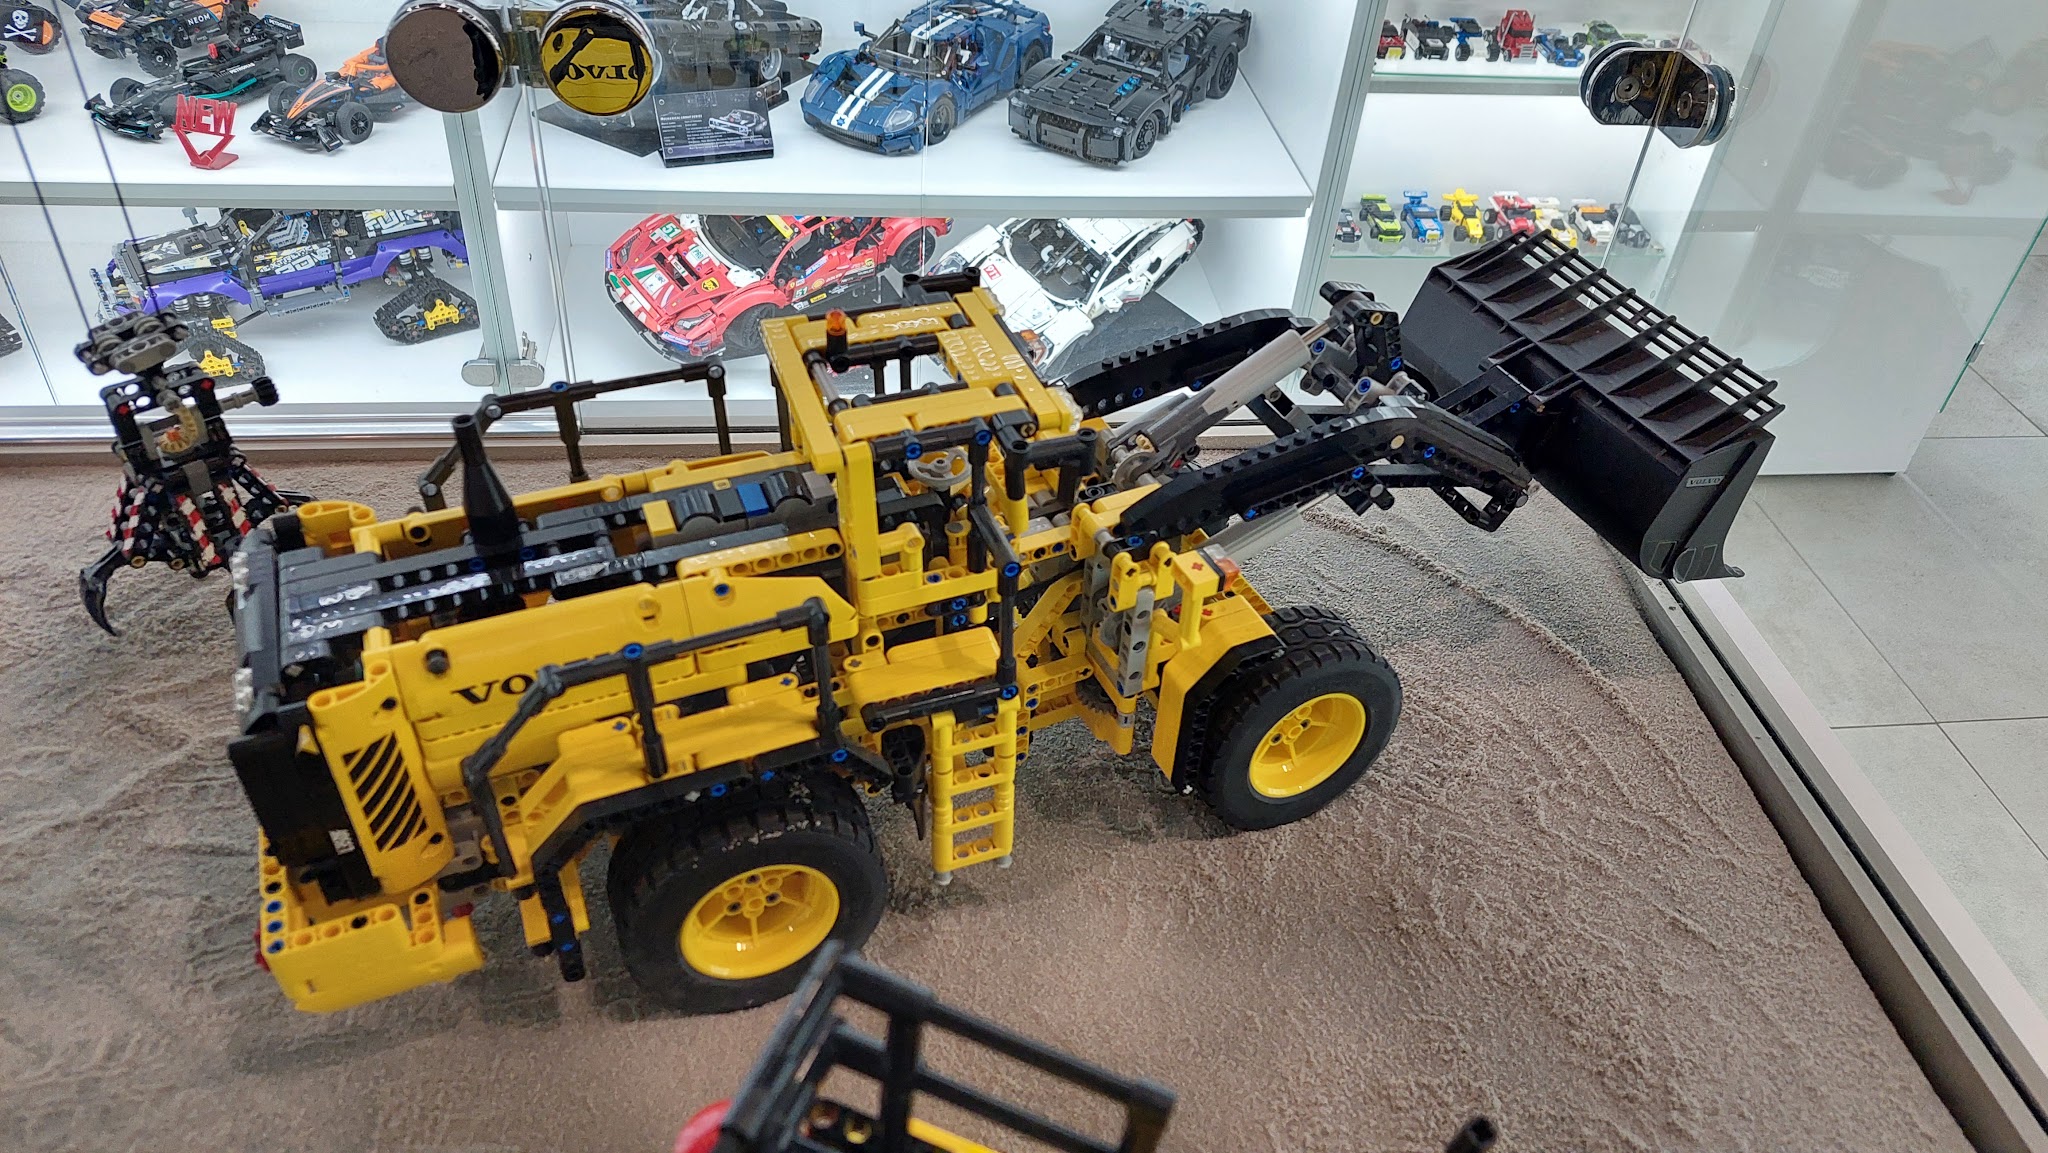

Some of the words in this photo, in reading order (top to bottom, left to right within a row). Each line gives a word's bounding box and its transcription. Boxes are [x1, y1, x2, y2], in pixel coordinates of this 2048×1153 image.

[187, 13, 211, 26] NEOM
[175, 94, 237, 135] NEW
[1690, 477, 1721, 485] VOLVO
[450, 672, 537, 705] VO
